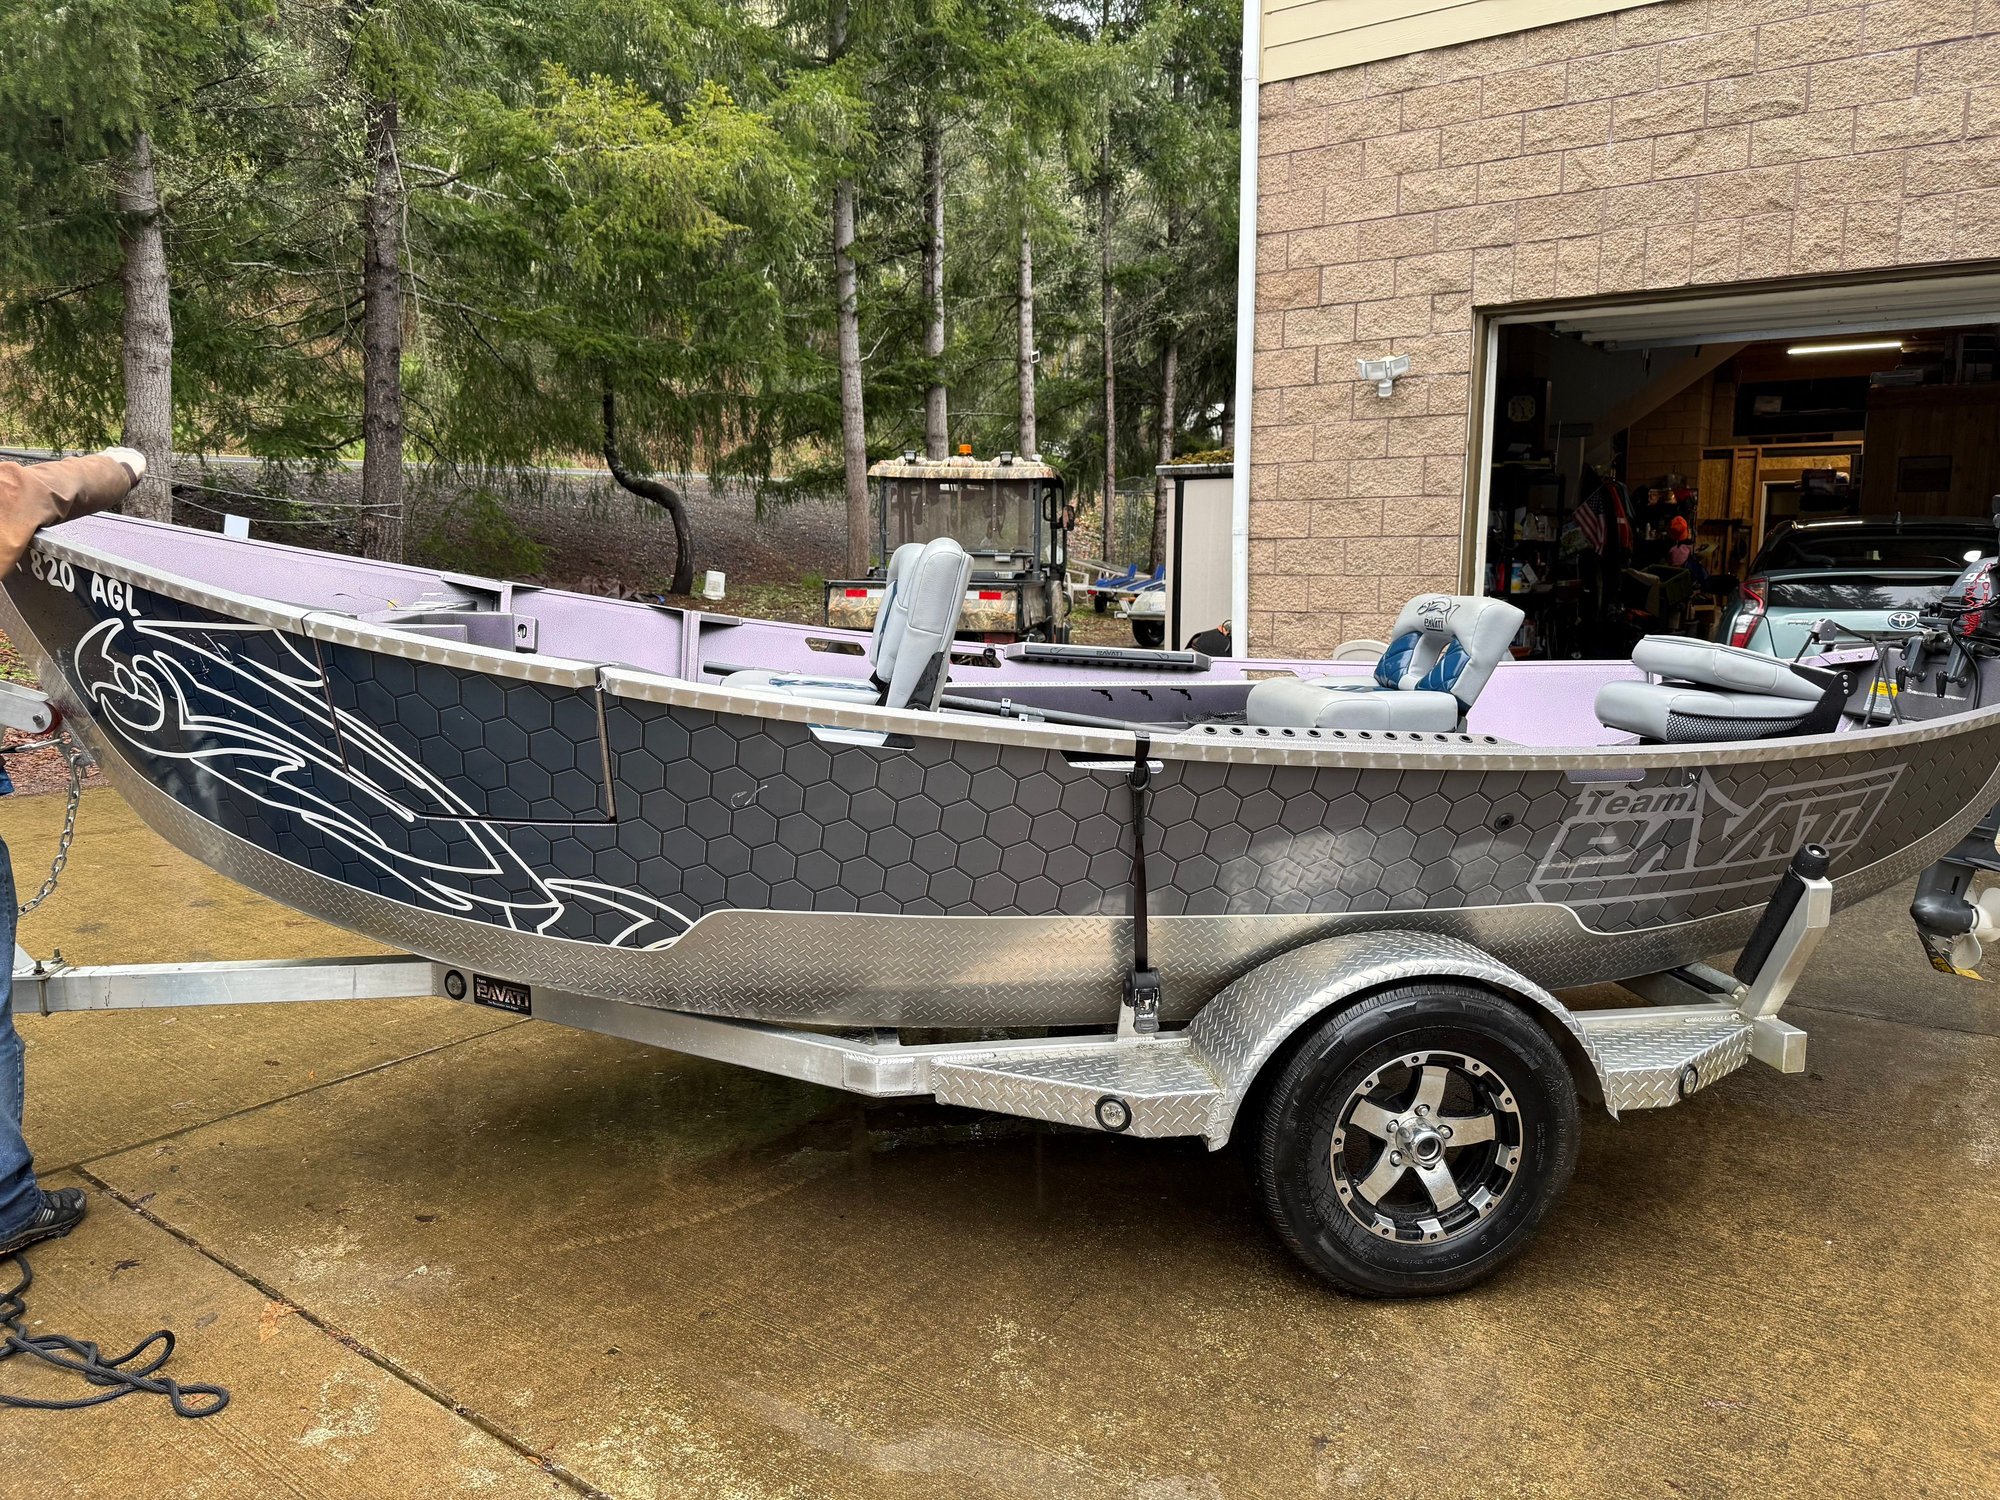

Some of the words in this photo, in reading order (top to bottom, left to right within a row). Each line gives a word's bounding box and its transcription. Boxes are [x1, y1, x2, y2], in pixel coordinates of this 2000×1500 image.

[30, 549, 75, 593] 820
[91, 572, 142, 617] AGL
[1585, 789, 1697, 816] Team
[476, 983, 529, 1007] PAVATI
